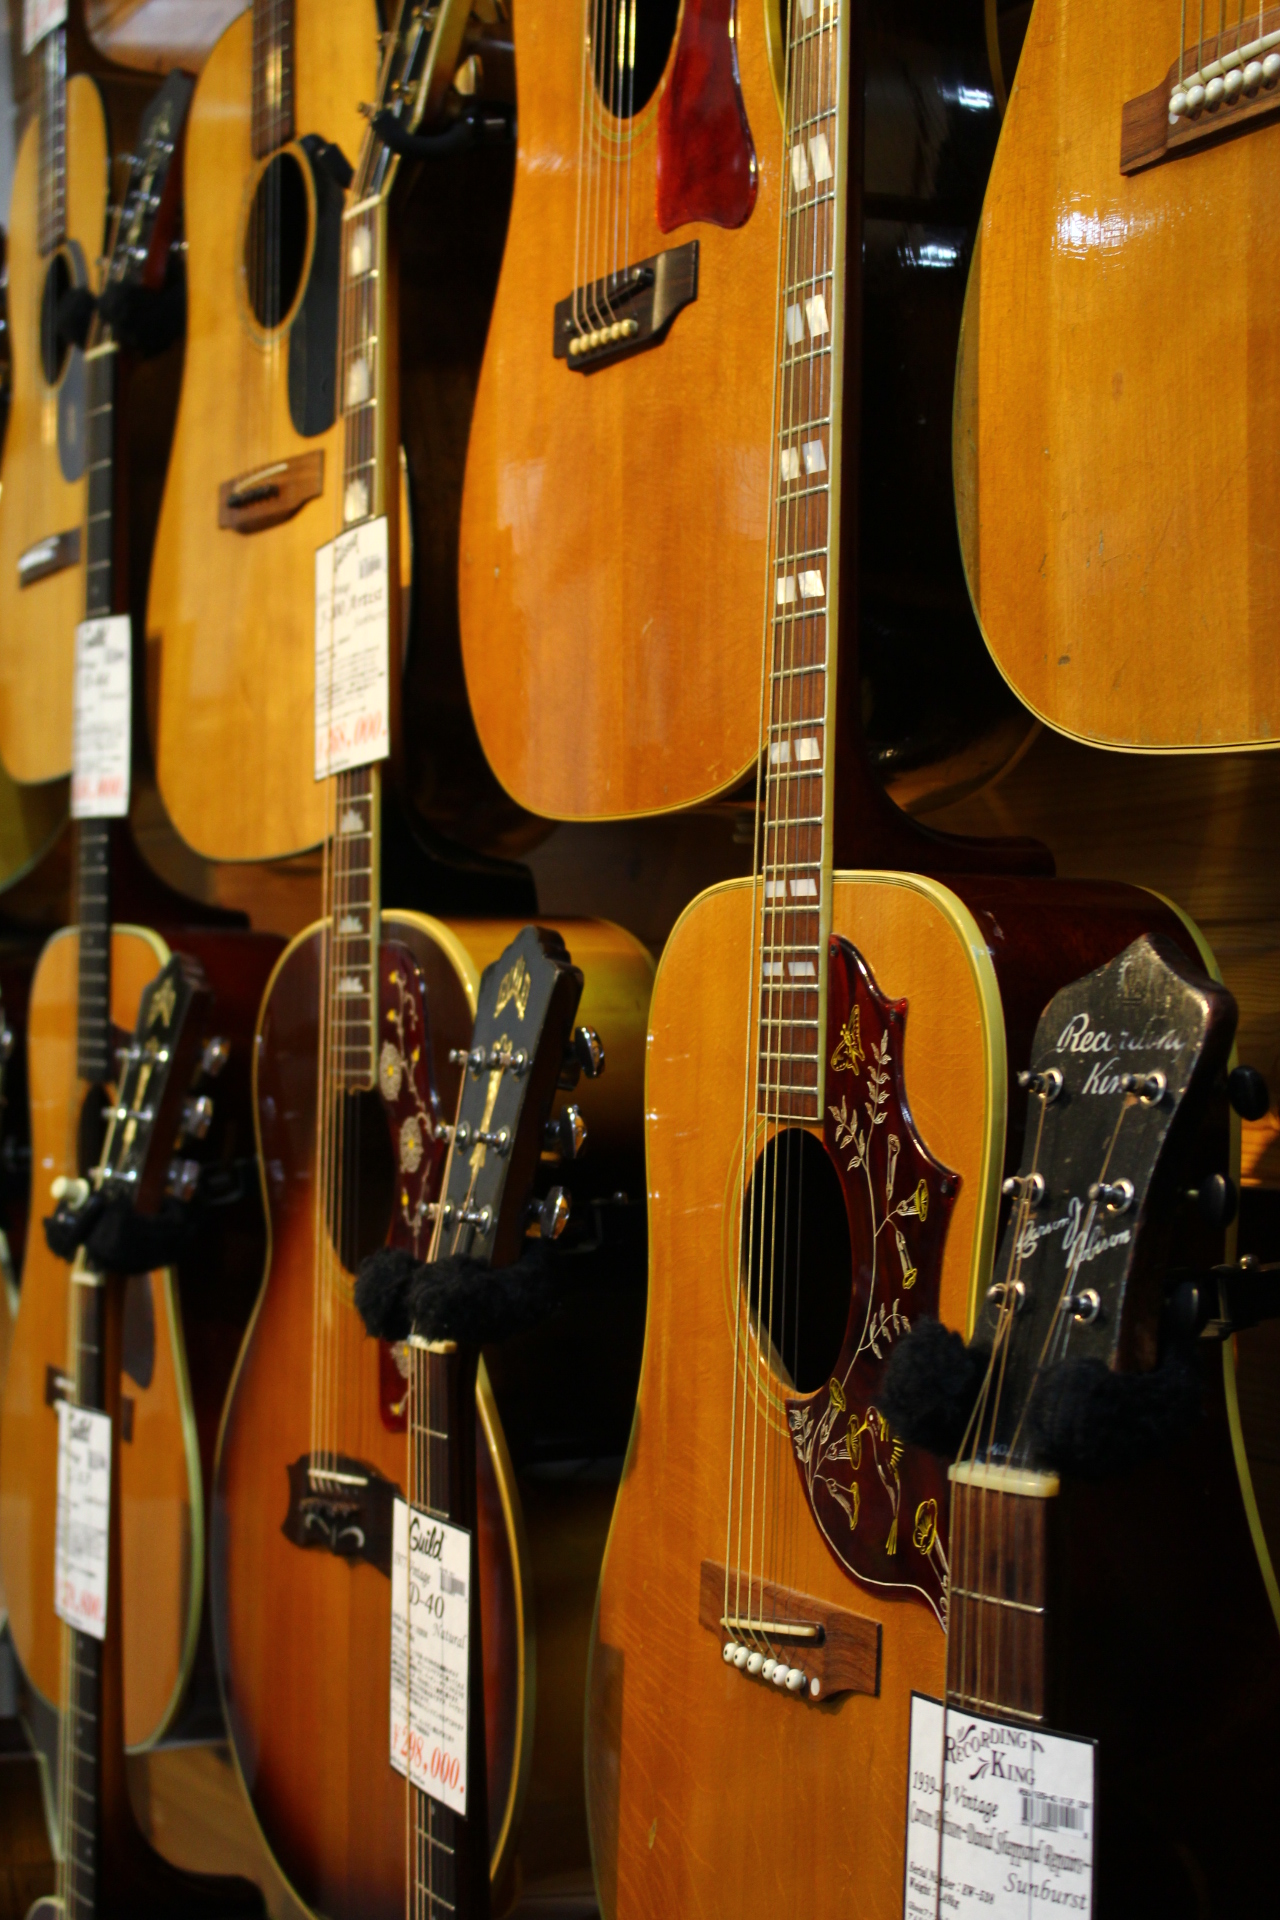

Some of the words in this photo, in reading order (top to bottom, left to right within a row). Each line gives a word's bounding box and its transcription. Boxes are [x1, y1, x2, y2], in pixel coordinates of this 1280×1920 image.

[1081, 1056, 1123, 1095] Kin
[409, 1516, 443, 1562] Guild
[409, 1581, 445, 1619] D-40
[945, 1727, 1028, 1764] RECORDING
[912, 1771, 951, 1802] 1939-0
[954, 1785, 999, 1823] Vintage
[1003, 1872, 1089, 1910] Sunburst
